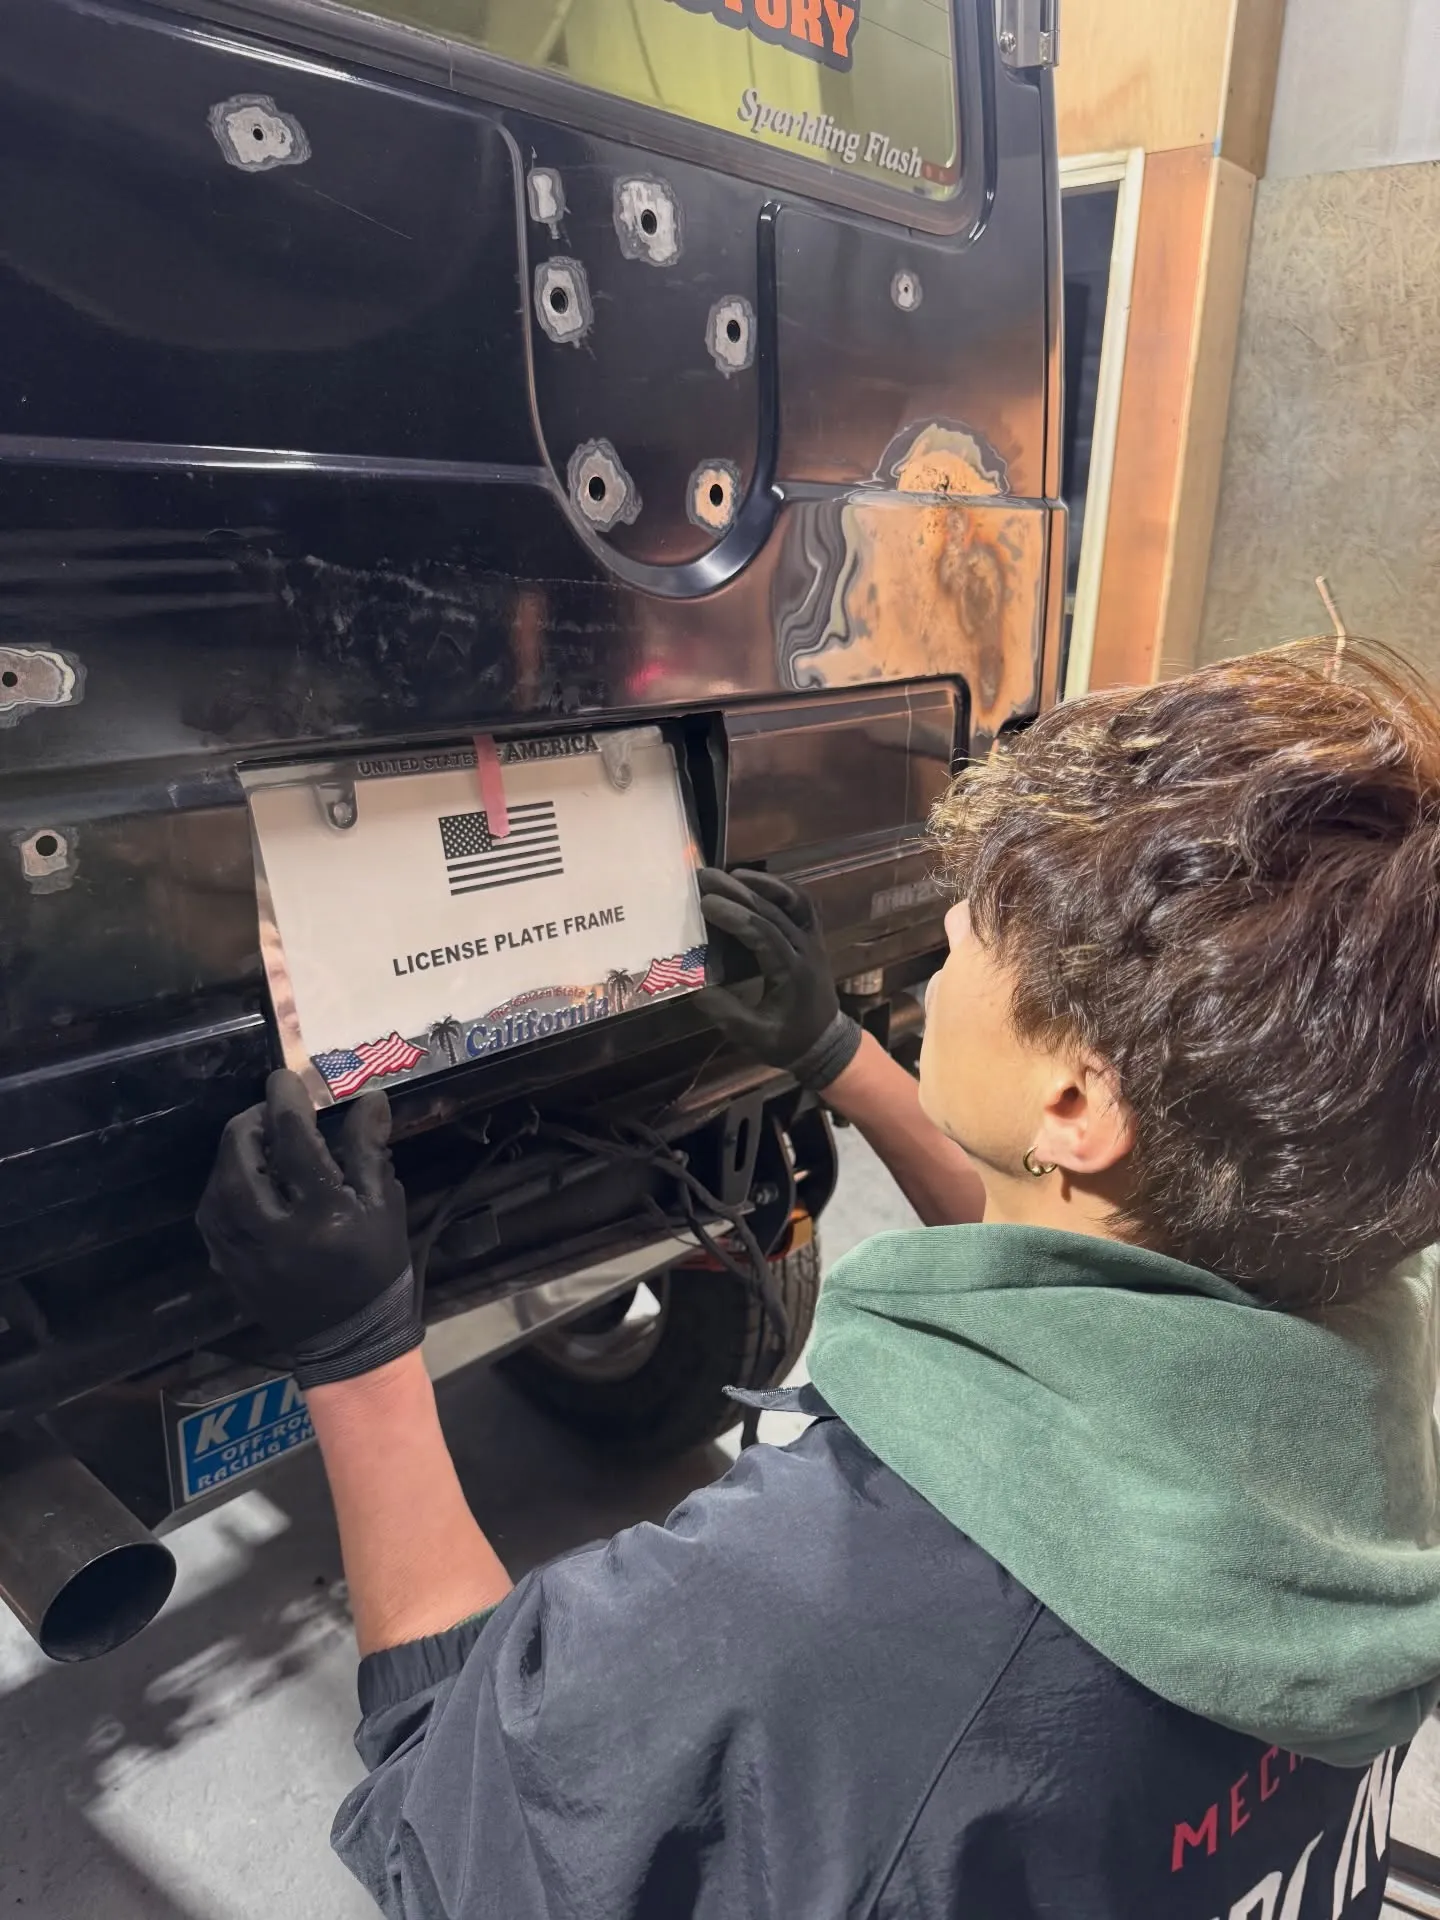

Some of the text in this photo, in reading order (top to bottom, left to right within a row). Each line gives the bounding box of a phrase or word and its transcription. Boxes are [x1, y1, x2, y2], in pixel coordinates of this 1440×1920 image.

[737, 87, 923, 178] Sparkling Flash
[357, 756, 420, 777] UNITED
[505, 733, 602, 764] AMERICA
[393, 905, 626, 976] LICENSE PLATE FRAME
[466, 991, 610, 1058] California
[197, 1444, 281, 1490] RACING
